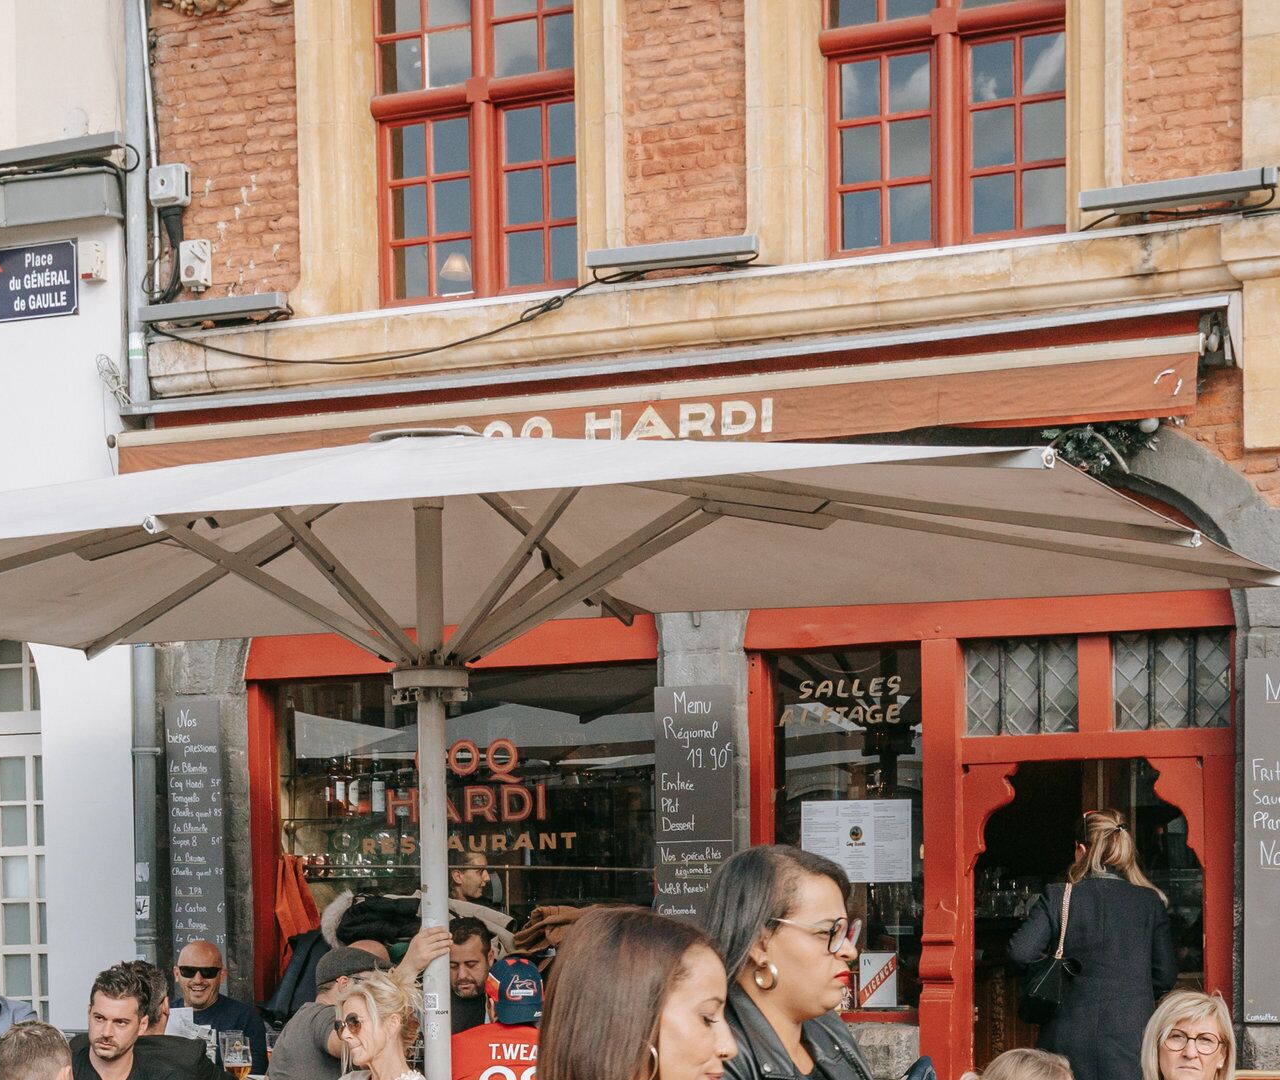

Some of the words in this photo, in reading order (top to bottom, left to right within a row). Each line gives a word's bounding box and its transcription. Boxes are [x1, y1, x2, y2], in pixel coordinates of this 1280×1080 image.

[25, 253, 53, 267] Place
[9, 276, 21, 291] du
[24, 269, 70, 289] GÉNÉRAL
[14, 296, 26, 311] de
[28, 291, 67, 310] GAULLE
[584, 398, 773, 440] HARDI
[799, 676, 902, 699] SALLES
[673, 691, 712, 714] Menu
[176, 709, 197, 728] Nos
[663, 716, 719, 749] Régional
[184, 745, 218, 758] pressions
[415, 738, 522, 783] OQ
[170, 777, 183, 792] Coq
[661, 772, 695, 791] Entrée
[661, 797, 680, 813] Plat
[662, 814, 696, 832] Dessert
[362, 832, 577, 854] RESAURANT
[660, 847, 676, 862] Nos
[681, 846, 722, 866] spécialités
[189, 887, 202, 895] IPA
[658, 882, 681, 895] Welsh
[864, 960, 894, 998] LICENCE
